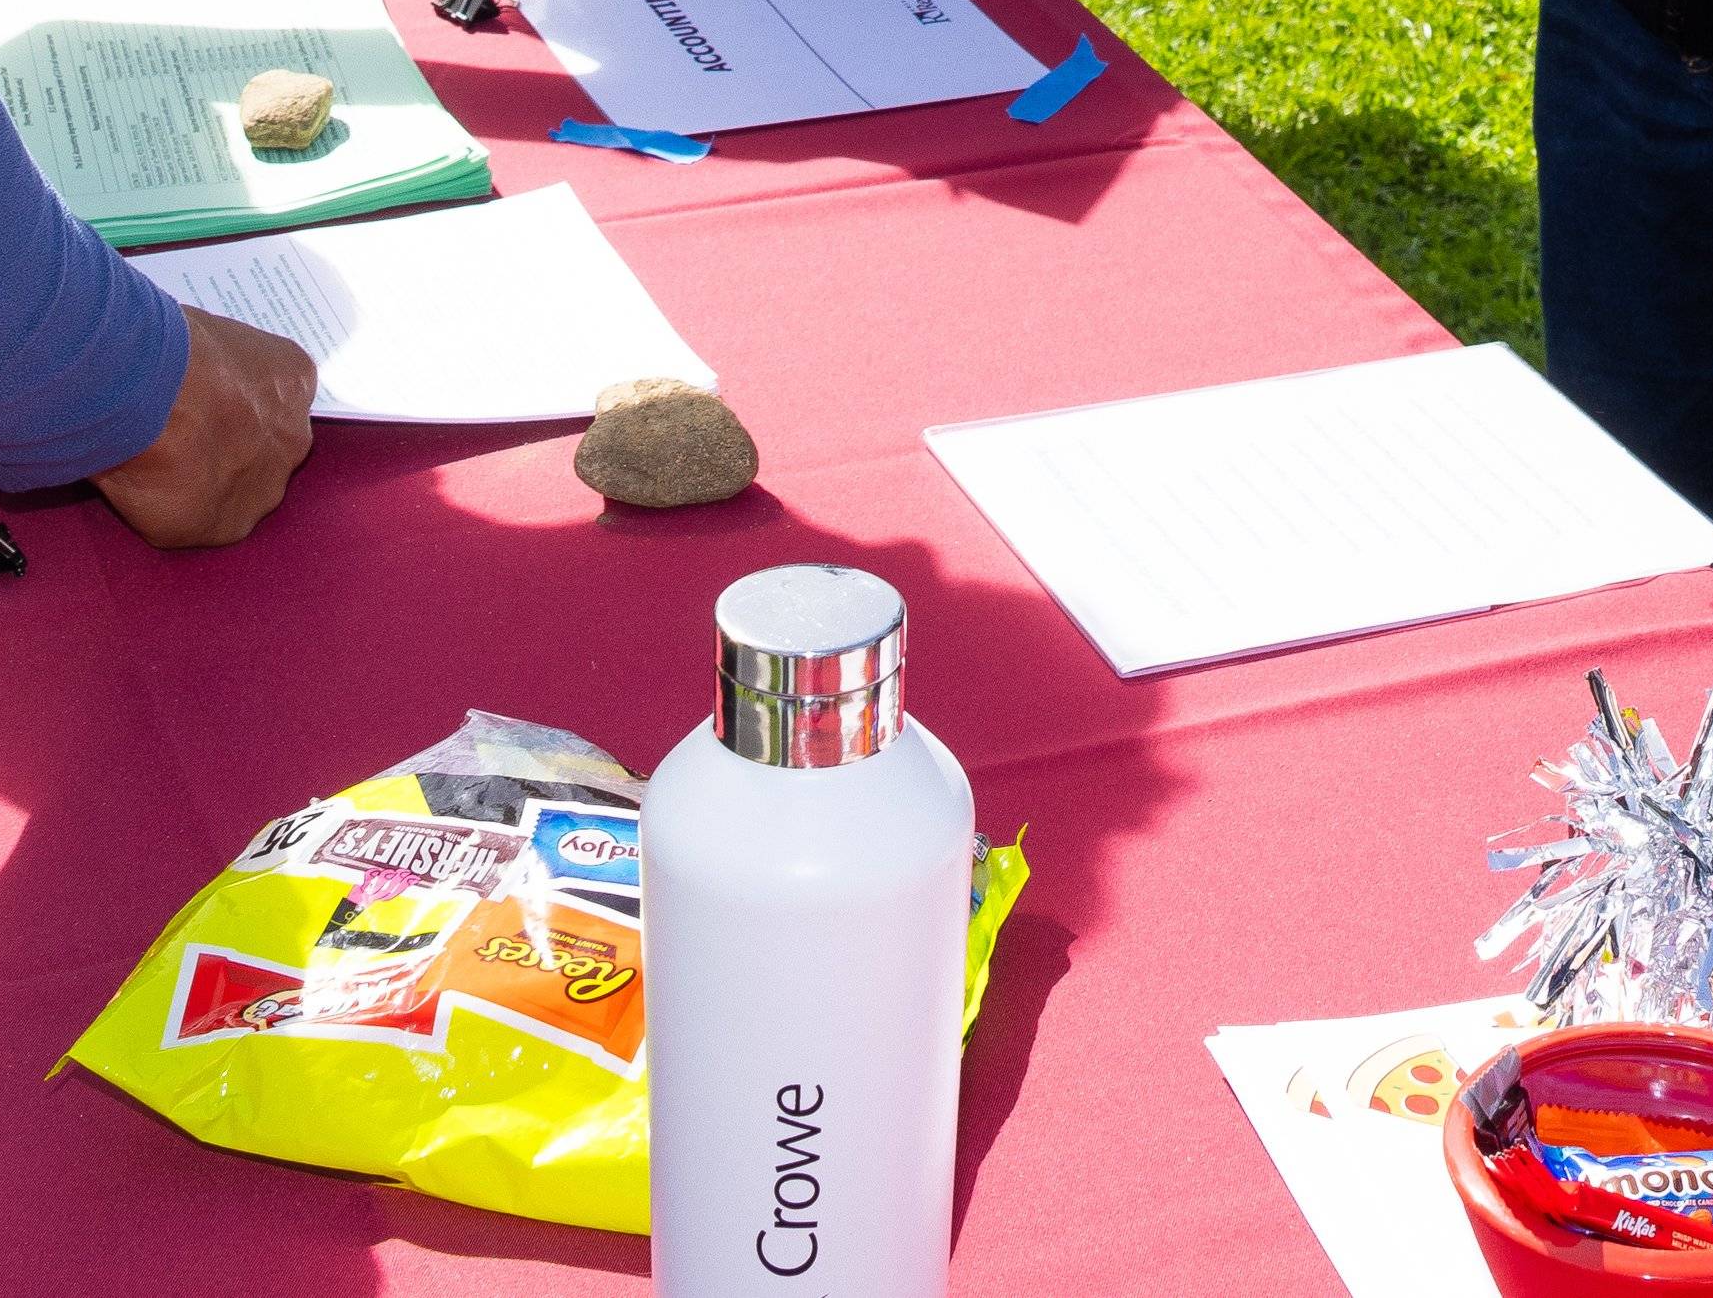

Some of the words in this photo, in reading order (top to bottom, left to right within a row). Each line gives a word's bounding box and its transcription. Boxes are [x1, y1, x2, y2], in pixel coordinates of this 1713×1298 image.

[334, 826, 499, 883] HERSHEY'S
[561, 835, 610, 859] Joy
[474, 935, 637, 1005] Reese's
[755, 1084, 824, 1277] Crowe
[1671, 1231, 1693, 1242] CRISP
